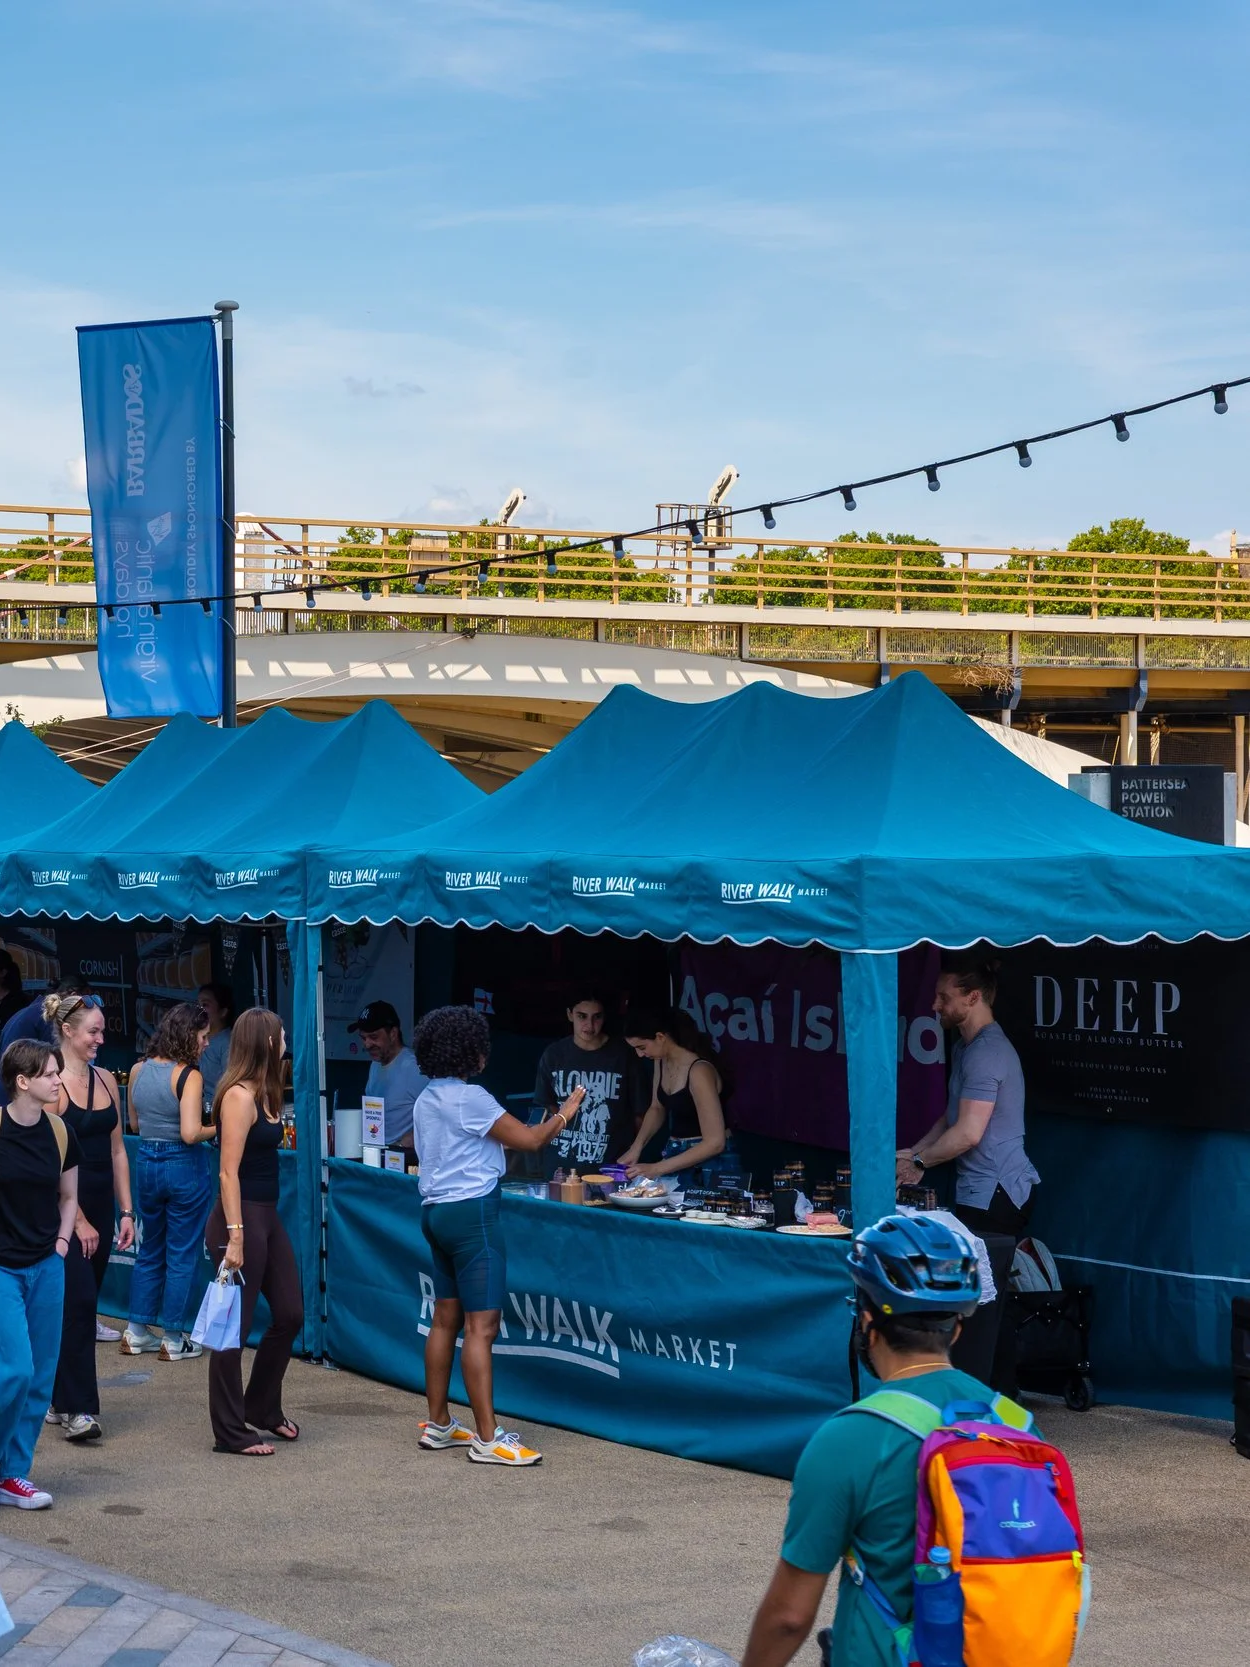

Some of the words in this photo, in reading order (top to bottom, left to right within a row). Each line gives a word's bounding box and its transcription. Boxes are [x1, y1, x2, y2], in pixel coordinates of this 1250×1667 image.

[1121, 778, 1190, 790] BATTERSEA
[1121, 806, 1175, 818] STATION
[31, 870, 50, 884] RIVER
[51, 869, 71, 882] WALK
[117, 872, 138, 886] RIVER
[138, 872, 160, 884] WALK
[215, 872, 236, 887] RIVER
[237, 868, 258, 883] WALK
[328, 870, 352, 885] RIVER
[354, 869, 379, 884] WALK
[445, 871, 472, 887] RIVER
[474, 870, 502, 886] WALK
[504, 876, 529, 884] MARKET
[572, 875, 602, 892] RIVER
[604, 875, 636, 891] WALK
[638, 882, 667, 890] MARKET
[721, 883, 752, 900] RIVER
[757, 883, 793, 900] WALK
[797, 888, 829, 896] MARKET
[79, 959, 119, 977] CORNISH
[1032, 974, 1181, 1036] DEEP
[678, 974, 778, 1054] Açaí
[1088, 1035, 1132, 1046] ALMOND
[1140, 1039, 1184, 1049] BUTTER
[508, 1291, 621, 1363] WALK
[629, 1326, 738, 1372] MARKET
